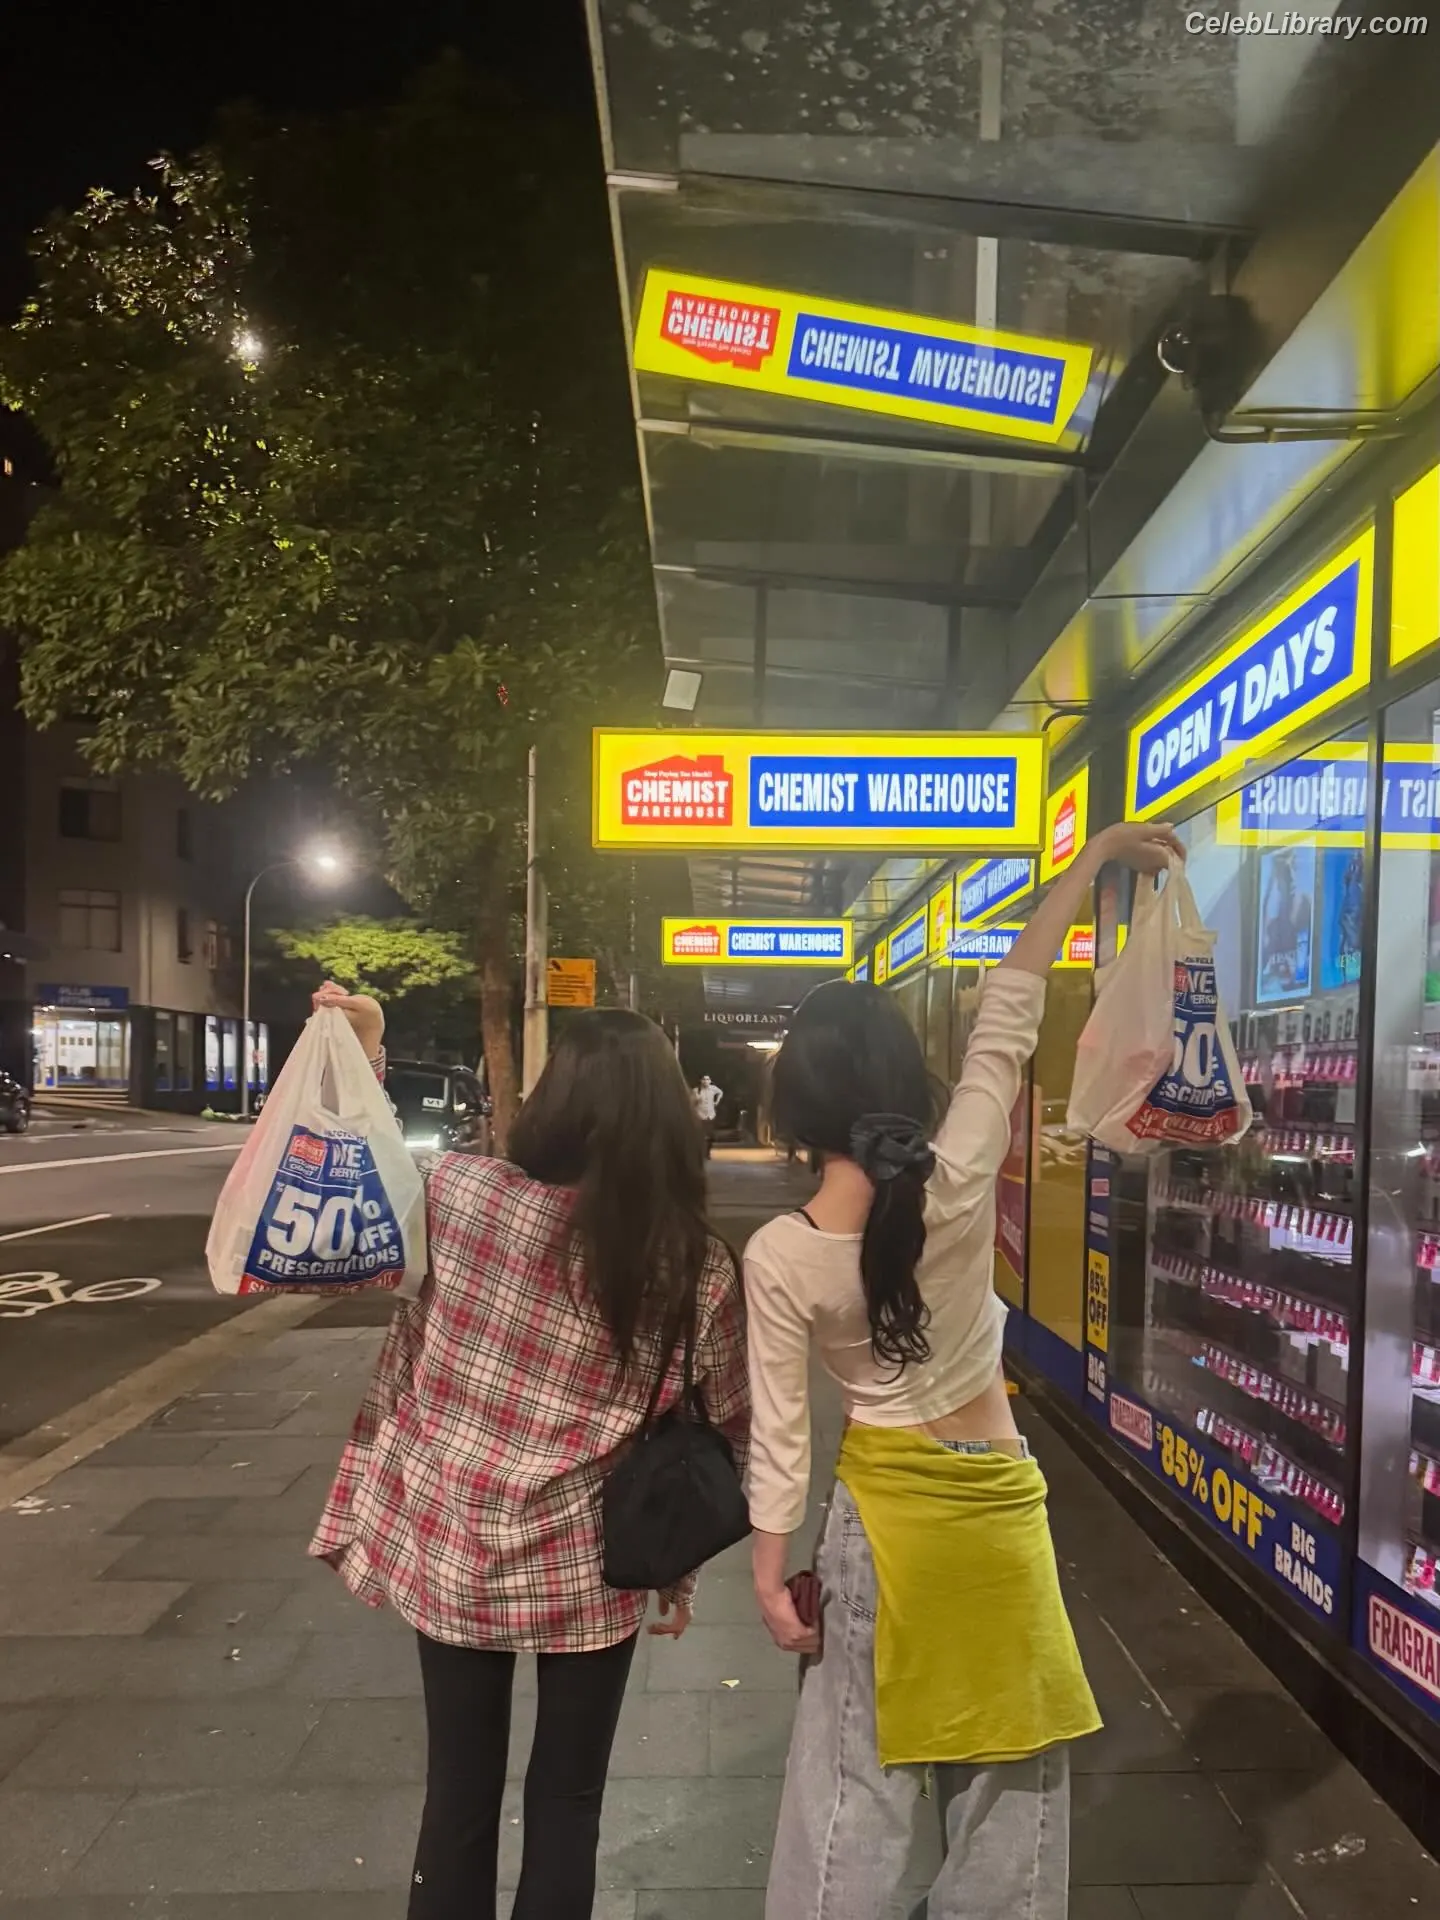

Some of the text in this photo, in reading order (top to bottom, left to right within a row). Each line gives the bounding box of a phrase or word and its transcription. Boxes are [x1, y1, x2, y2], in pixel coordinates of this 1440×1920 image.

[1146, 606, 1338, 788] OPEN 7 DAYS
[627, 779, 729, 803] CHEMIST
[627, 805, 725, 818] WAREHOUSE
[758, 772, 1010, 813] CHEMIST WAREHOUSE
[732, 933, 842, 952] CHEMIST WAREHOUSE
[1161, 1425, 1208, 1504] 85%
[1212, 1468, 1264, 1549] OFF
[1291, 1522, 1316, 1565] BIG
[1275, 1543, 1333, 1615] BRANDS
